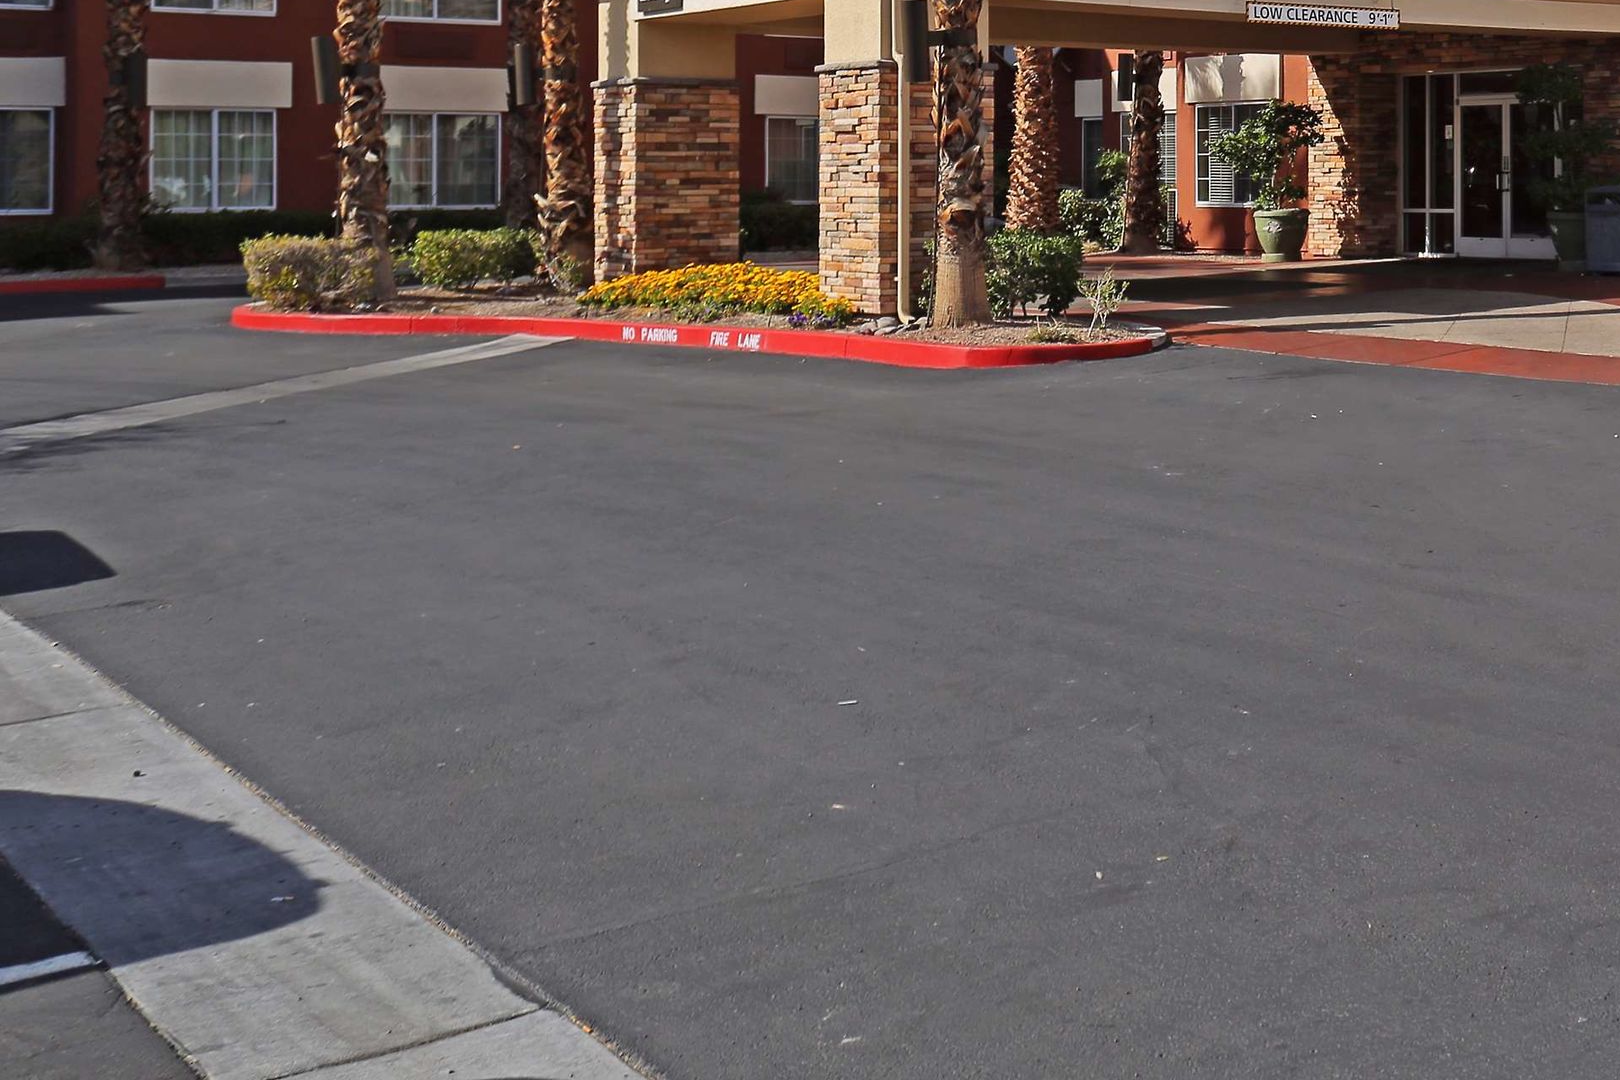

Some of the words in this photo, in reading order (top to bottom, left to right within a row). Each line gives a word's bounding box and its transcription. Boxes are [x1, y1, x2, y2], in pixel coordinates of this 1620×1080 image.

[1253, 6, 1283, 20] LOW
[1286, 8, 1358, 24] CLEARANCE
[622, 326, 635, 341] NO
[641, 327, 678, 343] PARKING
[710, 331, 730, 347] FIRE
[737, 333, 761, 350] LANE
